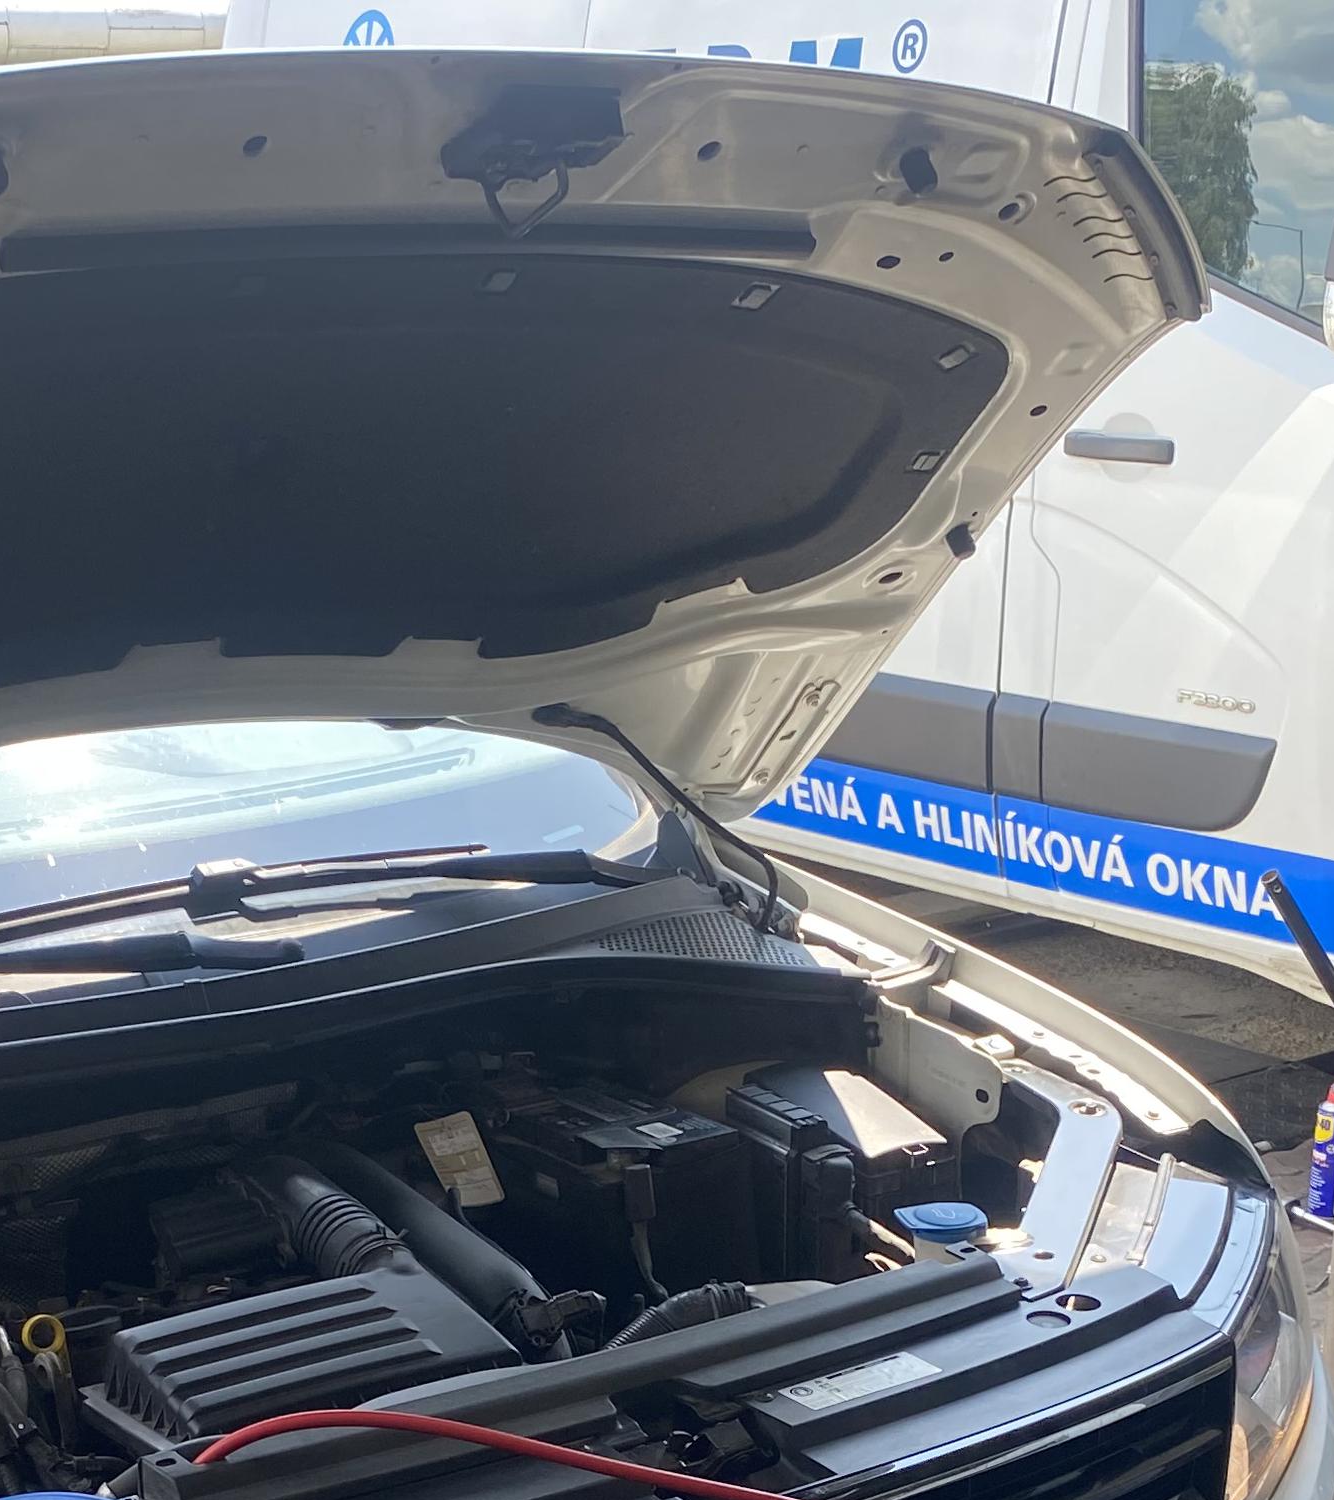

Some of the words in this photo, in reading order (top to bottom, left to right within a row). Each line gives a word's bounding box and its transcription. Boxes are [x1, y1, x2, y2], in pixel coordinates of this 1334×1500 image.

[877, 793, 906, 834] A
[913, 799, 1135, 888] HLINÍKOVÁ
[1146, 853, 1284, 922] OKNA
